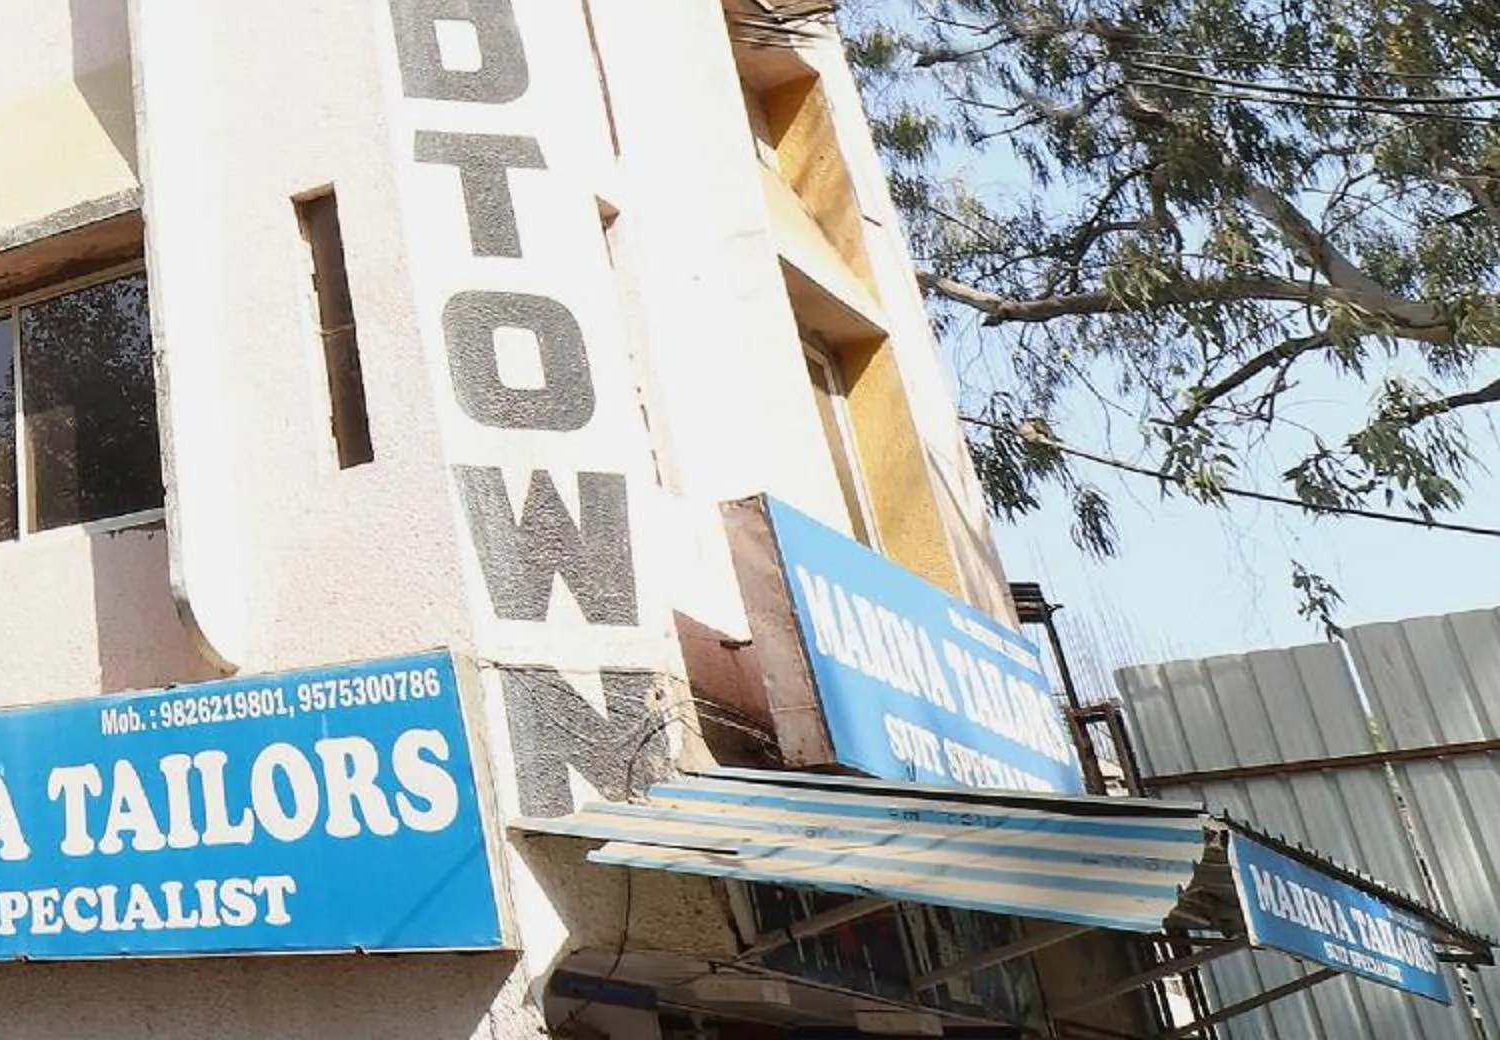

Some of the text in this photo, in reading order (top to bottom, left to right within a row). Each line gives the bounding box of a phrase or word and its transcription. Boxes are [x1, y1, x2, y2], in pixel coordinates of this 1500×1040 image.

[160, 687, 295, 728] 9826219801,
[298, 666, 441, 711] 9575300786
[796, 564, 958, 714] MARINA
[942, 638, 1071, 767] TAILORS
[47, 729, 459, 857] TAILORS
[1249, 864, 1437, 975] MARINA TAILORS
